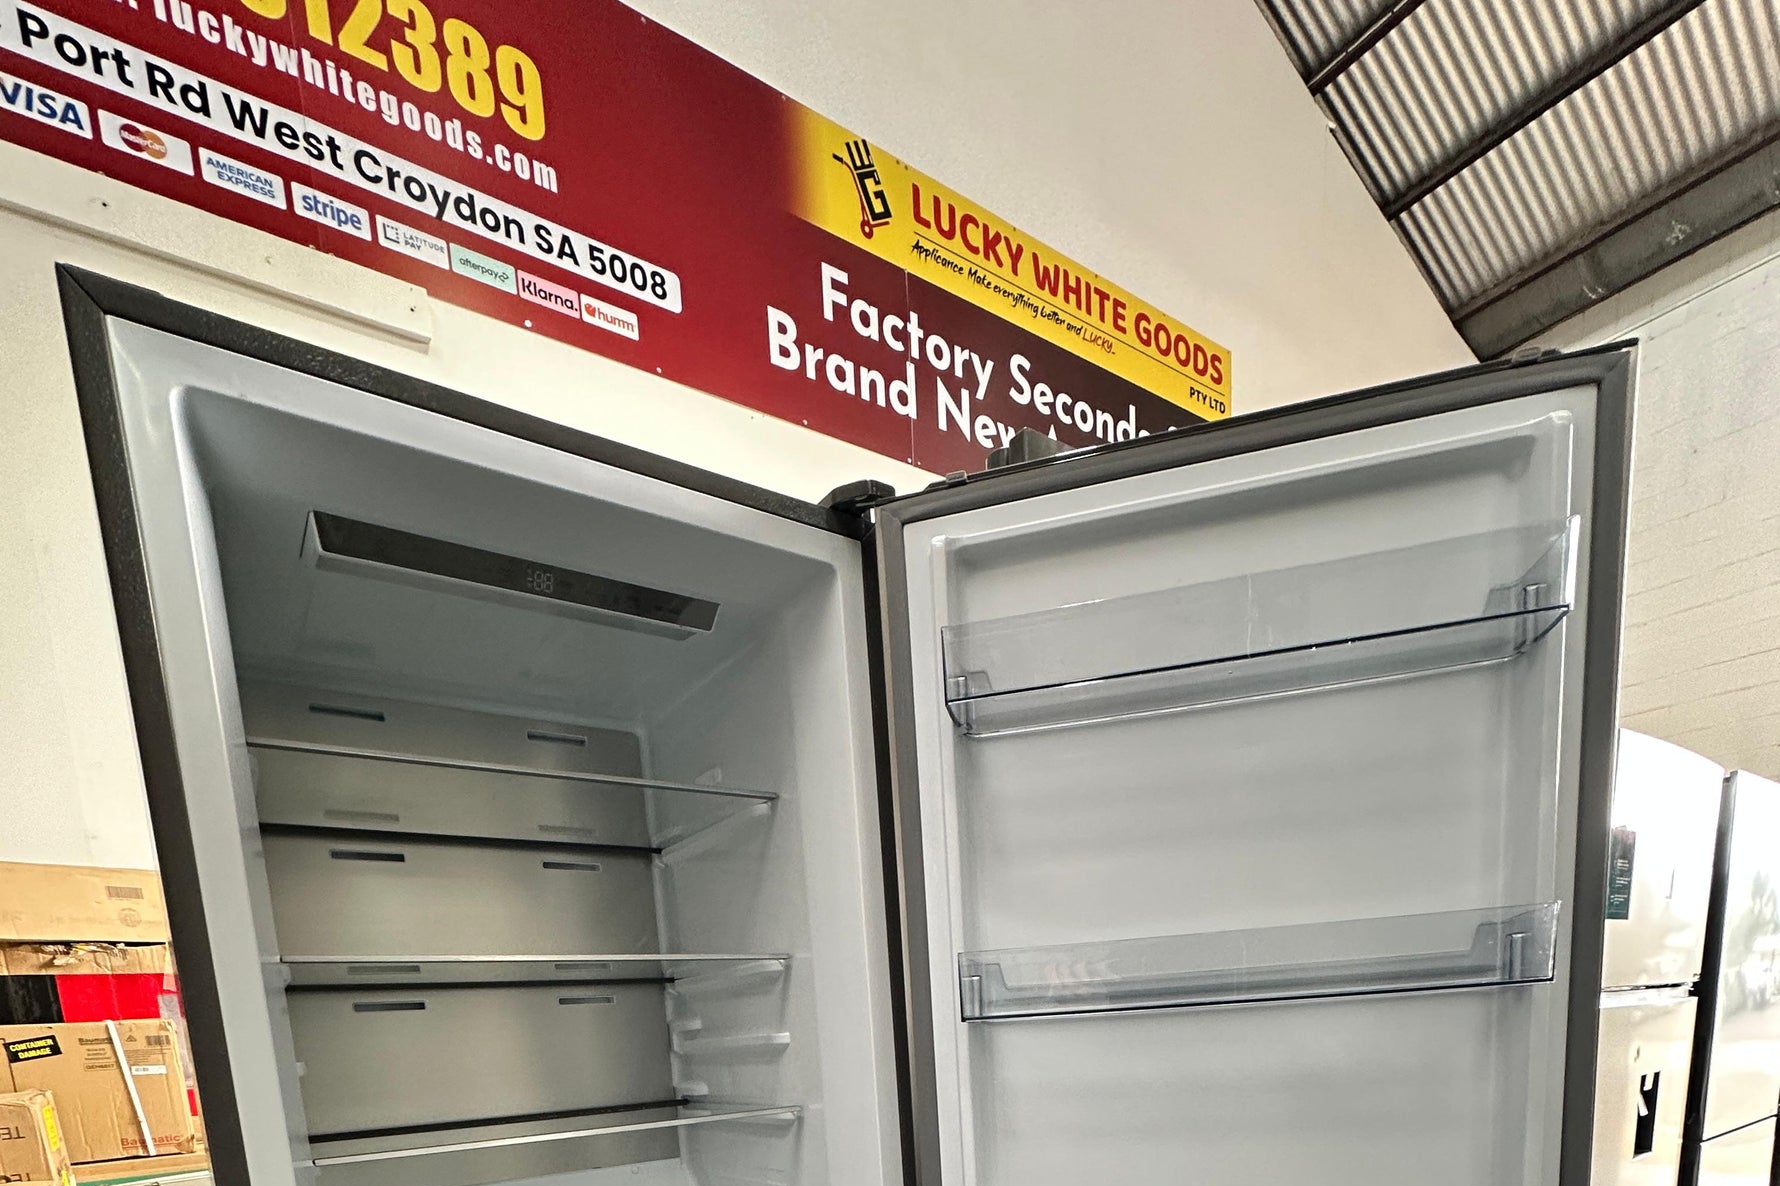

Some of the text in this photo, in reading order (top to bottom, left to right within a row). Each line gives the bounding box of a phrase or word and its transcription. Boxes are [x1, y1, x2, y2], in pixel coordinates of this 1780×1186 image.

[240, 0, 545, 141] 2389
[0, 77, 85, 131] VISA
[16, 8, 668, 300] Port Rd West Croydon SA 5008
[206, 157, 273, 189] AMERICAN
[217, 171, 276, 199] EXPRESS
[302, 192, 362, 230] stripe
[403, 231, 445, 254] LATITUDE
[404, 240, 422, 252] PAY
[459, 257, 499, 282] afterpay
[911, 183, 1223, 386] LUCKY WHITE GOODS
[521, 277, 578, 313] Klarna.
[968, 269, 992, 290] Make
[993, 285, 1038, 318] everything
[1040, 306, 1065, 326] better
[1066, 323, 1083, 336] and
[596, 308, 635, 333] humm
[767, 305, 917, 420] Brand
[821, 261, 1151, 444] Factory Second
[1189, 386, 1226, 414] PTY LTD
[9, 1038, 54, 1052] CONTAINER
[18, 1047, 52, 1059] DAMAGE
